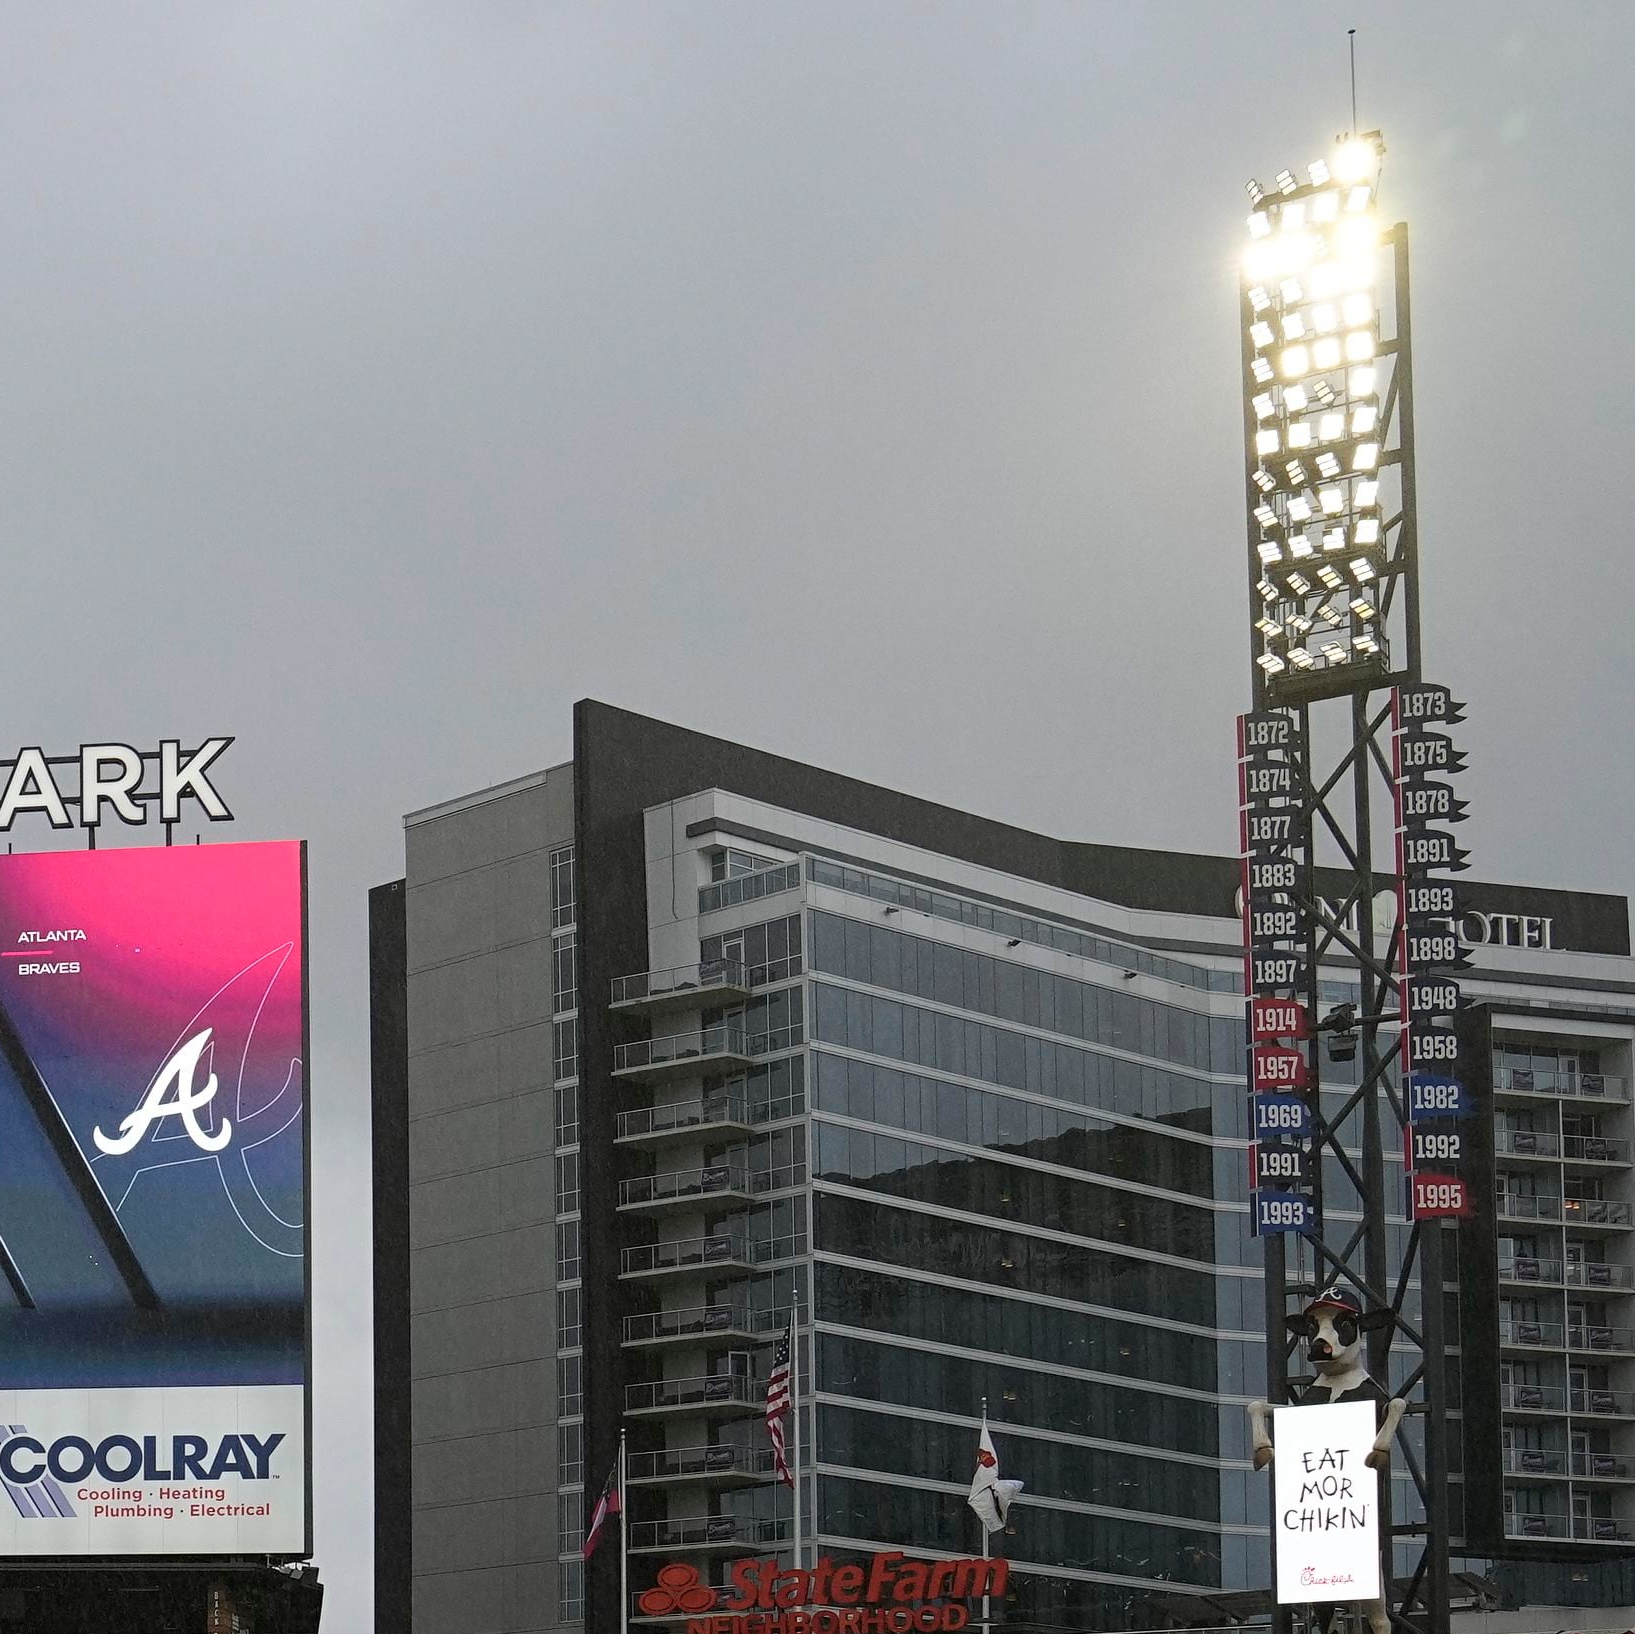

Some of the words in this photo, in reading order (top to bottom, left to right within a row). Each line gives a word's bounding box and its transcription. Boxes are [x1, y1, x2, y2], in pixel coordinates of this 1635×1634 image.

[1403, 692, 1446, 717] 1873
[1248, 721, 1289, 746] 1872
[1404, 740, 1447, 766] 1875
[1250, 769, 1291, 793] 1874
[1406, 789, 1449, 815] 1878
[1251, 816, 1291, 840] 1877
[1407, 838, 1450, 863] 1891
[1252, 863, 1295, 888] 1883
[1408, 887, 1453, 912] 1893
[1254, 911, 1296, 936] 1892
[17, 929, 87, 943] ATLANTA
[1410, 937, 1455, 961] 1898
[18, 962, 80, 975] BRAVES
[1255, 960, 1296, 984] 1897
[1411, 986, 1456, 1010] 1948
[1256, 1008, 1297, 1032] 1914
[1413, 1035, 1457, 1060] 1958
[1257, 1056, 1298, 1080] 1957
[1414, 1085, 1459, 1109] 1982
[1259, 1104, 1301, 1128] 1969
[1416, 1135, 1460, 1159] 1992
[1260, 1152, 1301, 1176] 1991
[1416, 1184, 1462, 1208] 1995
[1261, 1201, 1304, 1225] 1993
[0, 1432, 287, 1485] COOLRAY
[1302, 1447, 1350, 1474] EAT
[76, 1487, 143, 1502] Cooling
[158, 1486, 226, 1501] Heating
[1299, 1475, 1353, 1503] MOR
[93, 1504, 174, 1519] Plumbing
[189, 1502, 271, 1517] Electrical
[1283, 1504, 1366, 1532] CHIKIN
